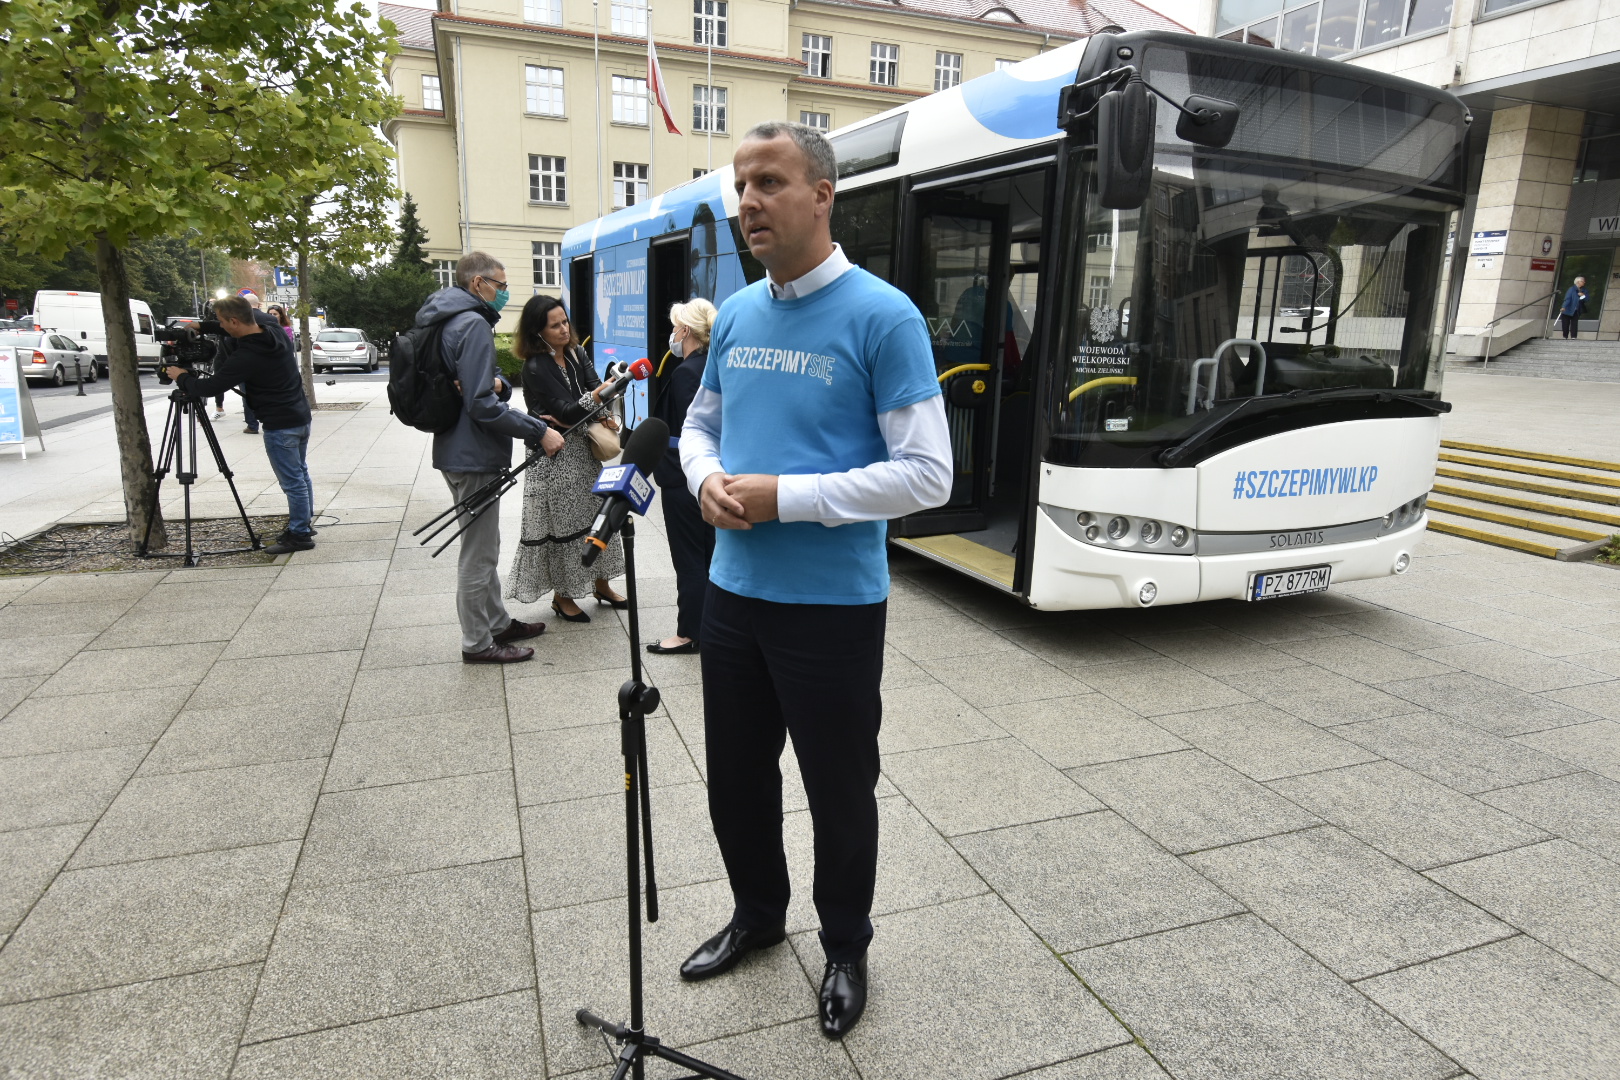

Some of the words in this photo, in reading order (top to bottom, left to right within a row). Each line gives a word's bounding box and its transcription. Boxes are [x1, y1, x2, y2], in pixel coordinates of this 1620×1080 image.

[1072, 355, 1130, 365] WIELKOPOLSKI
[1079, 345, 1124, 355] WOJEWODA
[726, 346, 836, 386] #SZCZEPIMYSIĘ
[1233, 465, 1378, 499] #SZCZEPIMYWLKP
[1270, 531, 1324, 548] SOLARIS
[1264, 575, 1283, 594] PZ
[1286, 569, 1327, 591] 877RM
